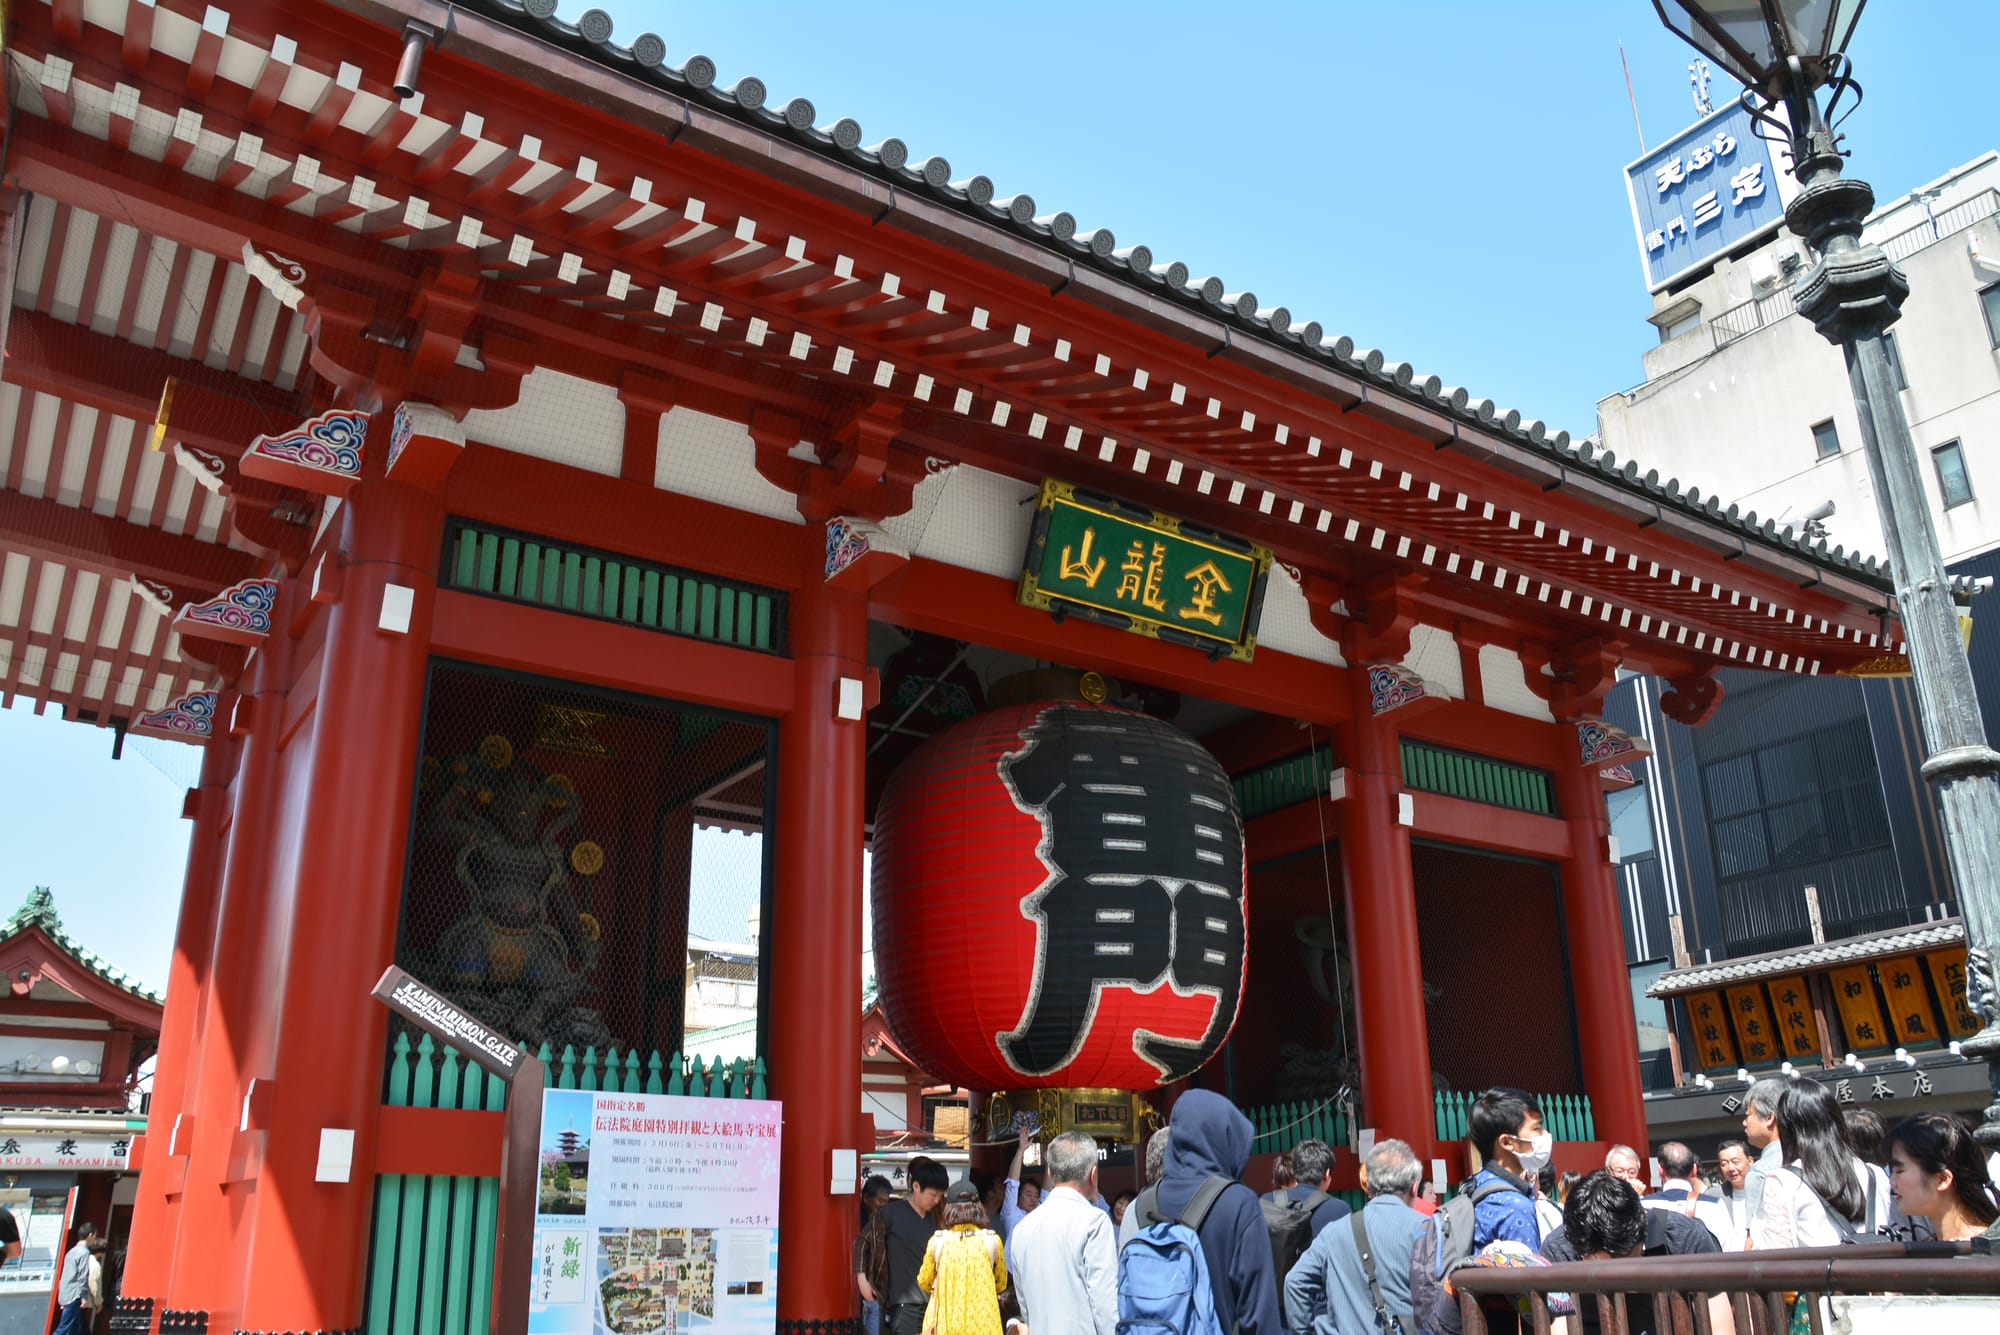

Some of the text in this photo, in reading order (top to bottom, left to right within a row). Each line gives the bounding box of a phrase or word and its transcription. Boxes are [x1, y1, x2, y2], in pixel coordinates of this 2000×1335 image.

[1655, 131, 1737, 193] 天ぷら
[1644, 162, 1766, 253] 雷門 三定
[403, 982, 518, 1062] KAMINARIMON GATE
[1782, 989, 1812, 1052] 千代紙
[1844, 980, 1875, 1041] 和紙
[1893, 971, 1927, 1034] 和風
[596, 1098, 646, 1113] 国指定名勝
[1834, 1069, 1934, 1103] 屋本店
[594, 1115, 778, 1138] 伝法院庭園特別拝観と大絵馬寺宝展
[57, 1158, 122, 1167] NAKAMISE
[560, 1236, 582, 1279] 新緑
